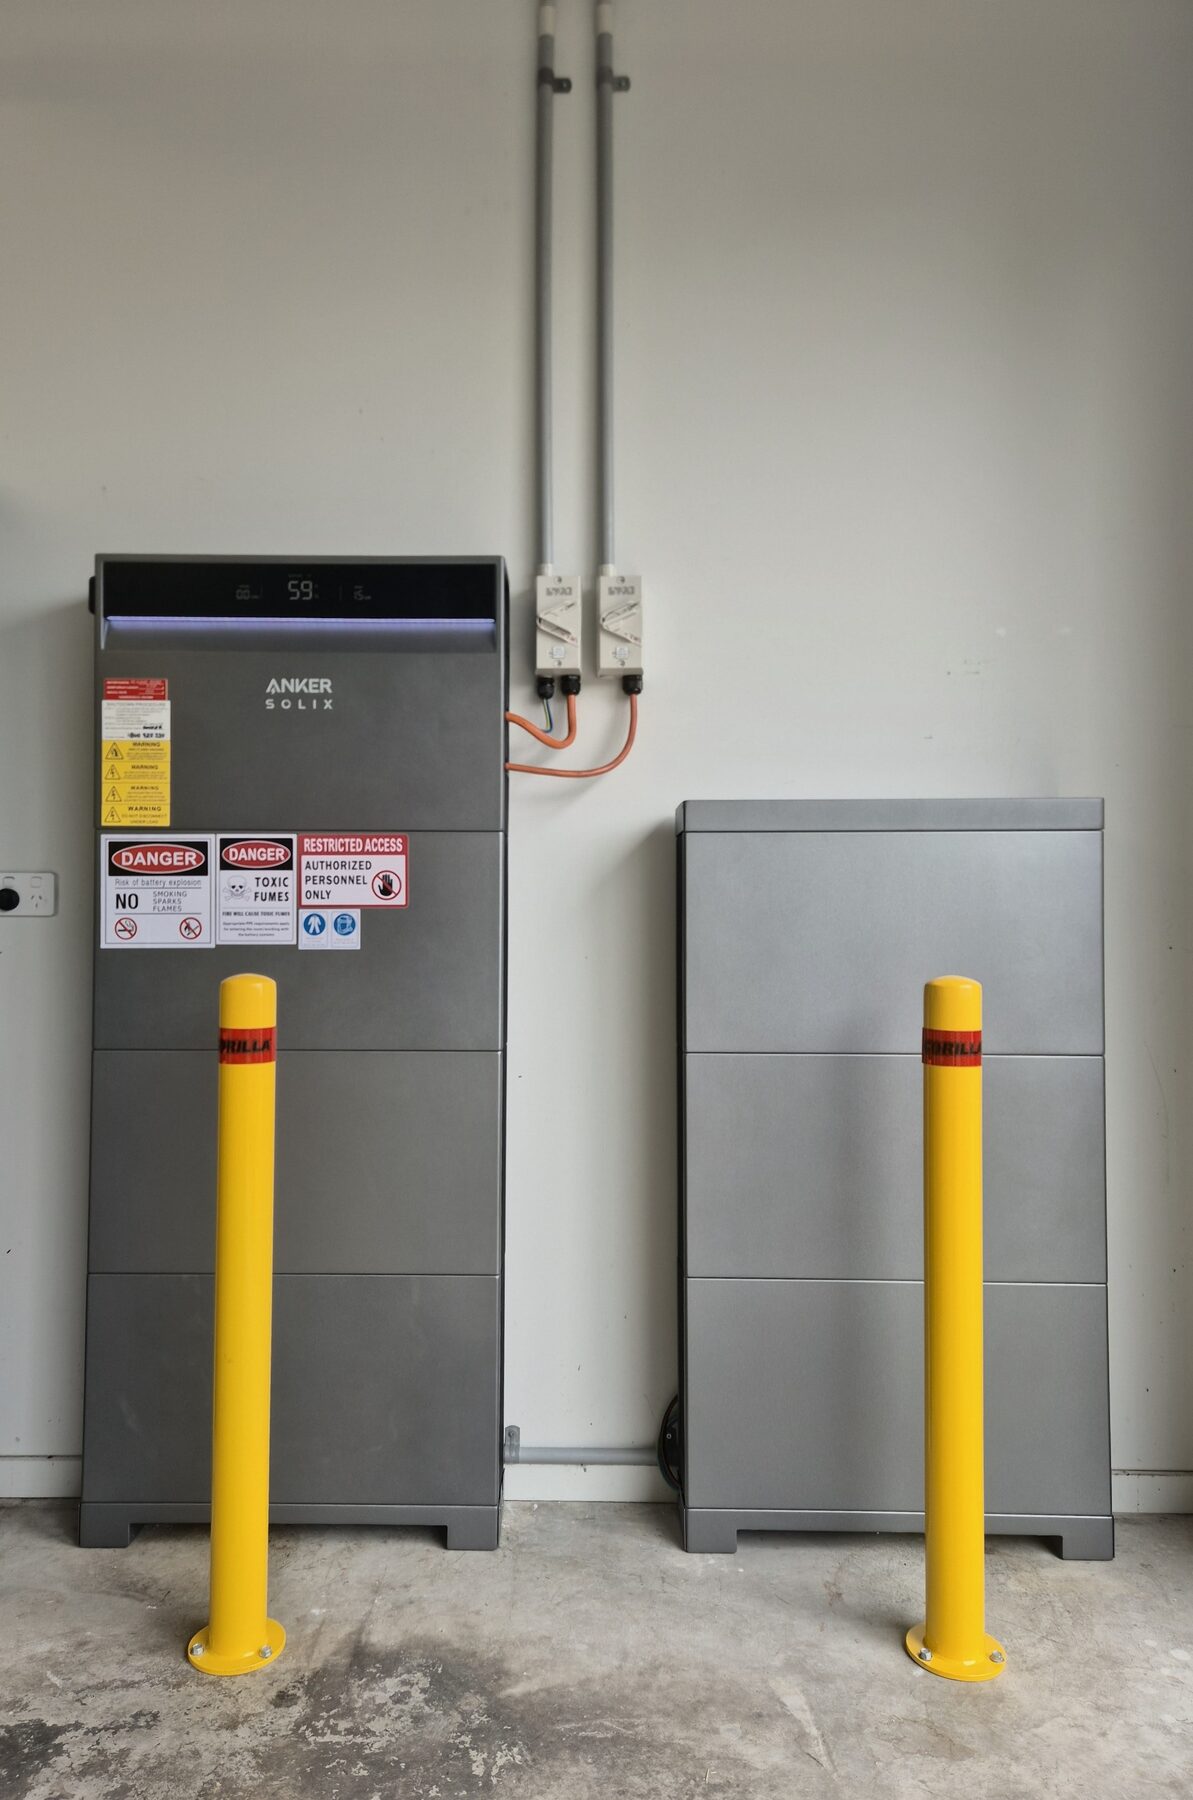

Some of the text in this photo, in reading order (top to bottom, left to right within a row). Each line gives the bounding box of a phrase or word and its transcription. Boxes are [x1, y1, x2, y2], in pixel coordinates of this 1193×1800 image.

[287, 580, 313, 600] 59
[265, 678, 333, 694] ANKER
[265, 698, 333, 710] SOLIX
[303, 838, 403, 852] RESTRICTED ACCESS
[121, 851, 197, 866] DANGER
[228, 847, 285, 861] DANGER
[304, 860, 372, 871] AUTHORIZED
[114, 878, 202, 889] Risk of battery explosion
[254, 877, 289, 888] TOXIC
[305, 875, 368, 885] PERSONNEL
[254, 892, 290, 902] FUMES
[305, 890, 332, 900] ONLY
[115, 893, 139, 910] NO
